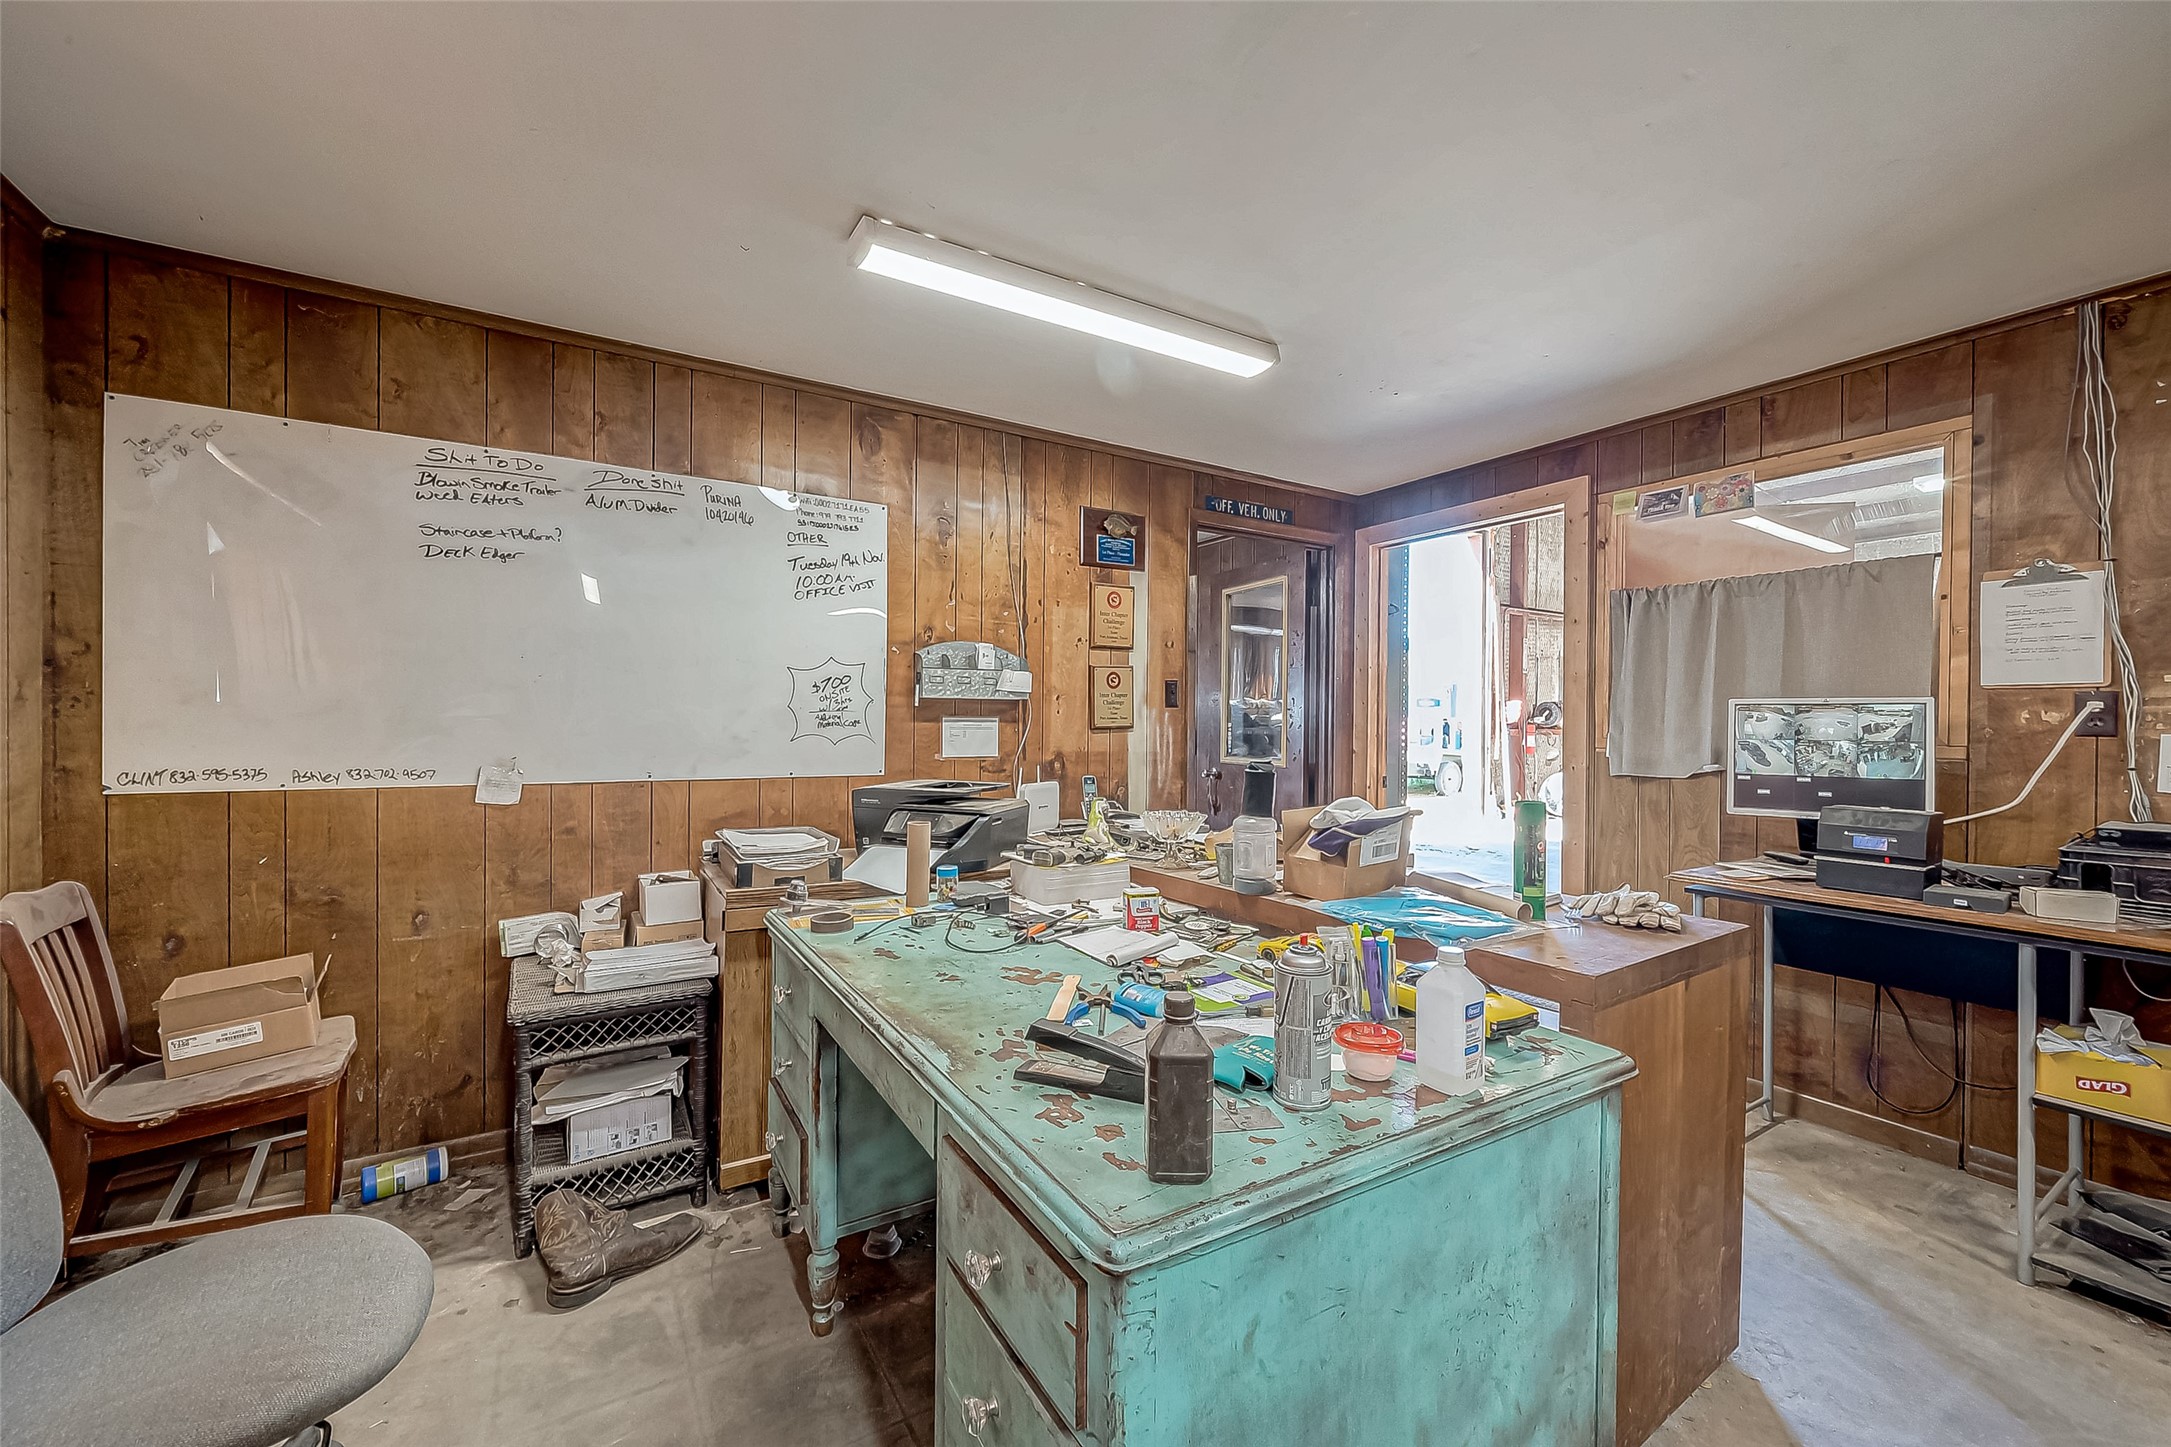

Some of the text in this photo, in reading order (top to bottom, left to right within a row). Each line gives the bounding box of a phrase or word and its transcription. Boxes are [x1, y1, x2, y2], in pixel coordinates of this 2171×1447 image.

[510, 457, 544, 471] Do
[470, 477, 520, 492] Smoke
[587, 470, 649, 490] Done
[1238, 502, 1260, 519] VEH.
[1262, 506, 1287, 524] ONLY
[418, 523, 496, 538] Staircase
[787, 531, 828, 544] OTHER
[787, 556, 838, 571] Tuesday
[794, 585, 845, 601] OFFICE
[811, 675, 852, 693] $700
[116, 769, 168, 787] CLINT
[292, 769, 341, 786] Ashley
[2078, 1079, 2127, 1094] GLAD
